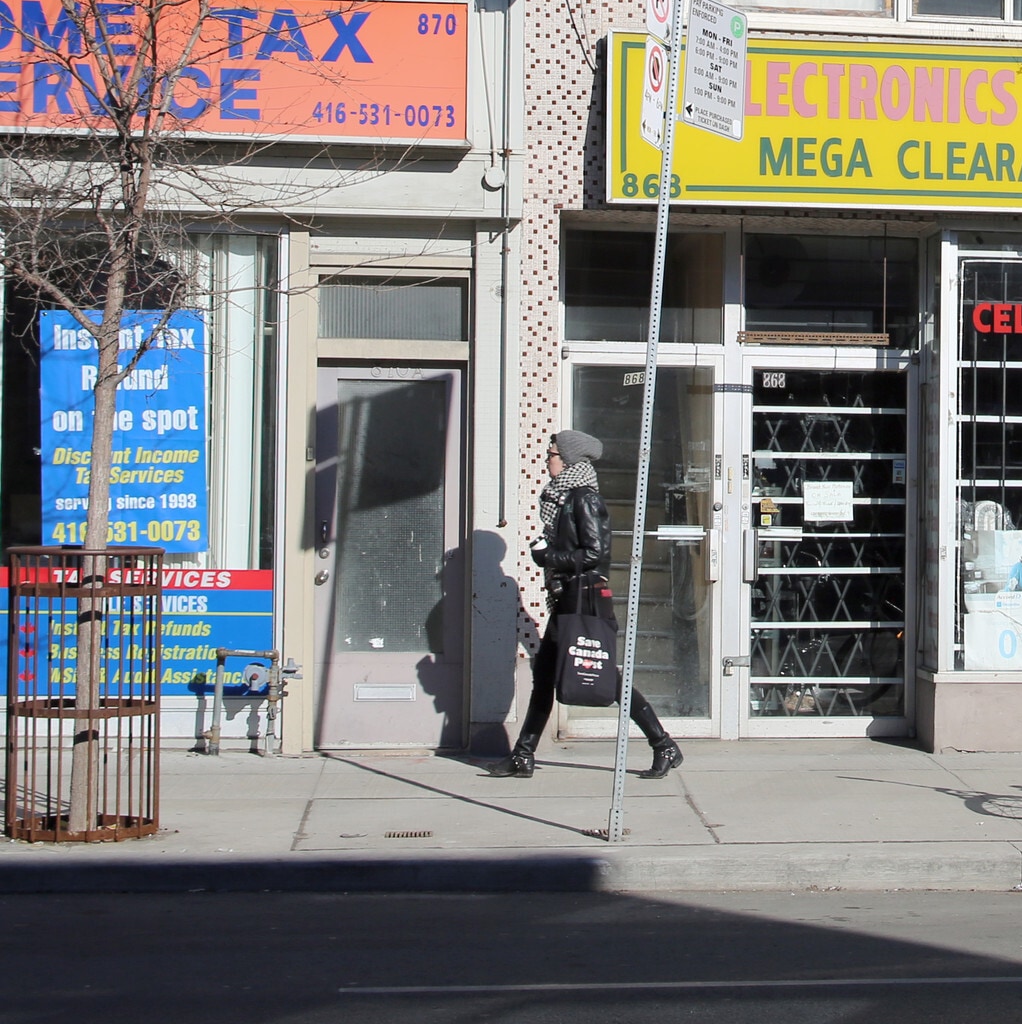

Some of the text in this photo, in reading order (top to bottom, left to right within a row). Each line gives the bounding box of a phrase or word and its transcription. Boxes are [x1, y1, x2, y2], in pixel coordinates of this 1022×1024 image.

[0, 0, 374, 63] ME TAX
[417, 13, 457, 36] 870
[702, 28, 718, 40] MON
[722, 36, 732, 47] FRI
[706, 50, 714, 60] PM
[730, 60, 738, 70] PM
[730, 49, 738, 58] PM
[710, 62, 722, 72] SAT
[708, 82, 722, 94] SUN
[728, 80, 738, 89] PM
[745, 60, 1018, 126] LECTRONICS
[704, 90, 713, 100] PM
[728, 98, 736, 108] PM
[312, 100, 456, 128] 416-531-0073
[758, 136, 873, 178] MEGA
[53, 323, 196, 350] Instnt Tax
[81, 364, 169, 391] Rfund
[625, 374, 644, 384] 868
[762, 372, 786, 388] 868
[53, 409, 84, 431] on
[142, 405, 199, 434] spot
[52, 446, 200, 464] Discnt Income
[109, 466, 185, 484] Services
[116, 494, 155, 510] since
[159, 492, 197, 509] 1993
[52, 519, 201, 544] 416531-0073
[107, 570, 231, 588] SERVICES
[51, 619, 106, 636] Instt
[47, 643, 218, 664] Busess Registratio
[568, 646, 610, 660] Canada
[160, 668, 247, 684] Assistanc
